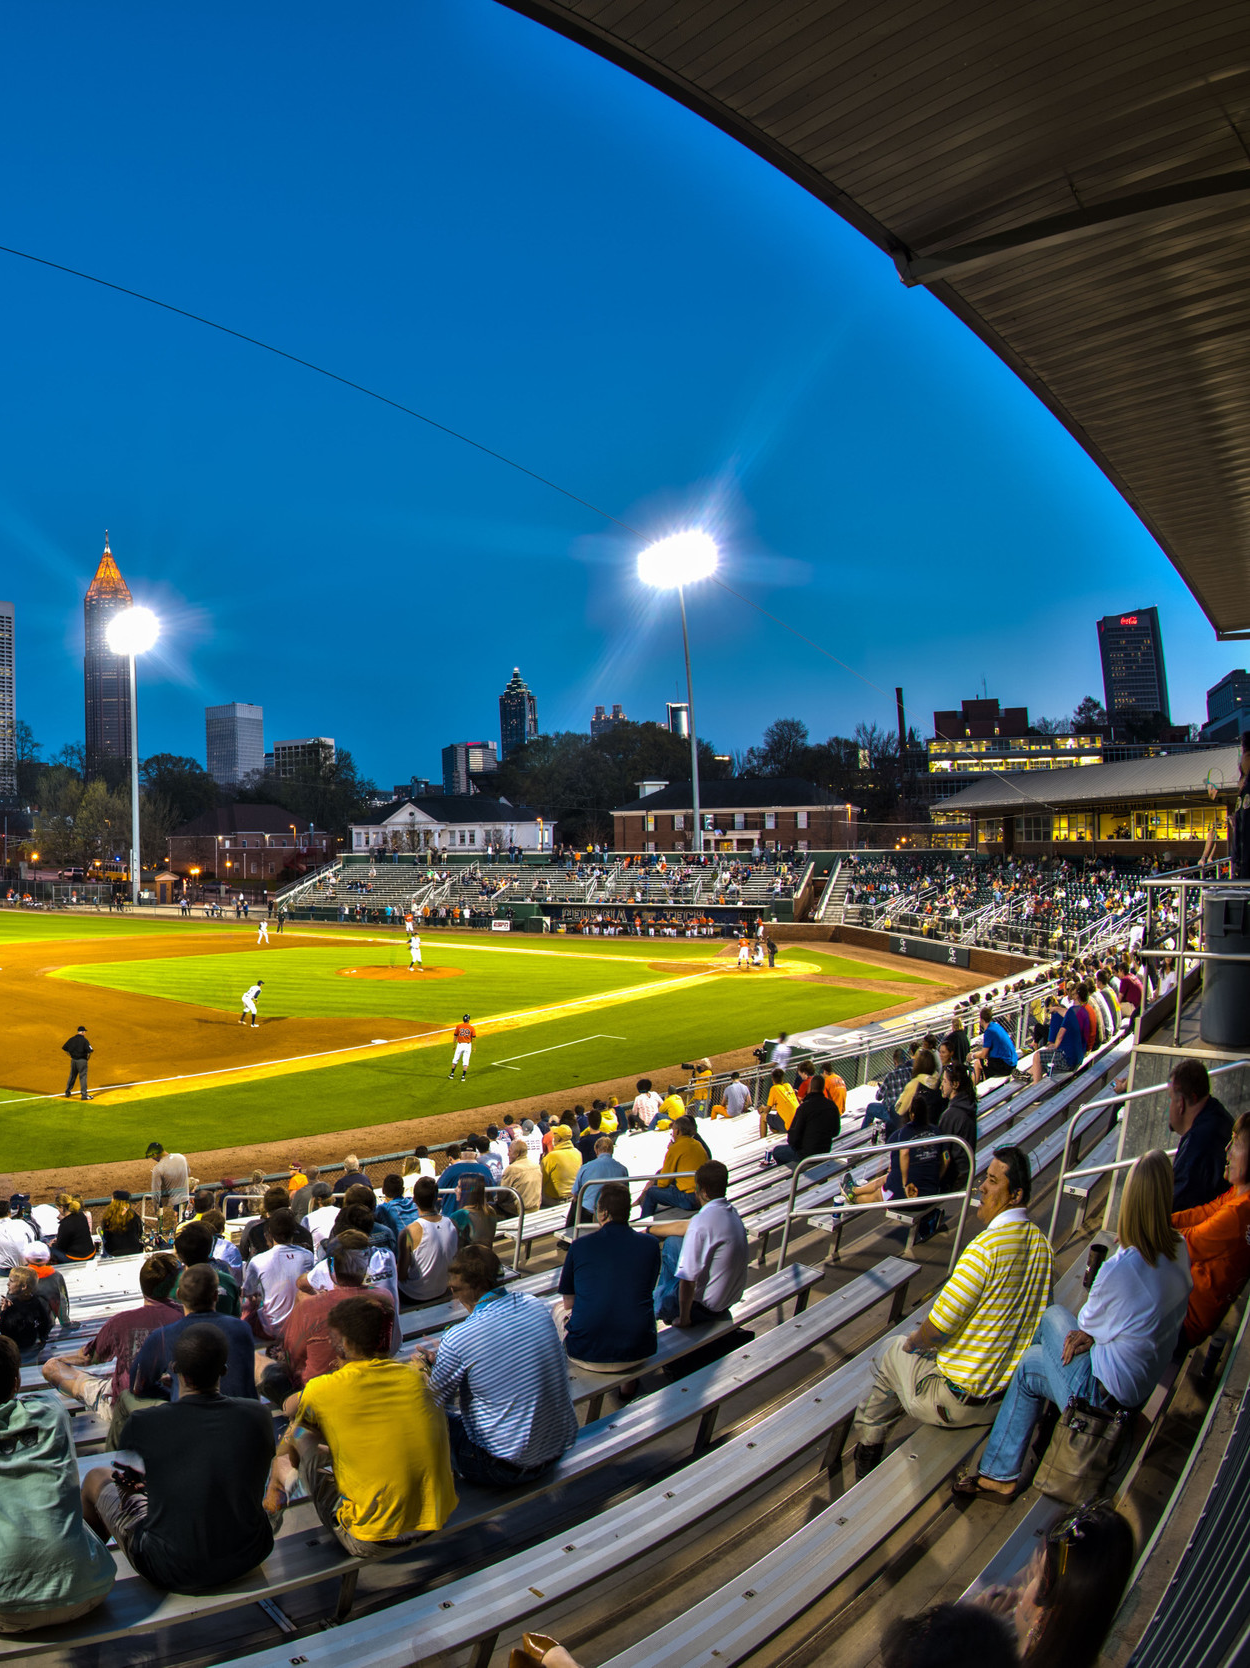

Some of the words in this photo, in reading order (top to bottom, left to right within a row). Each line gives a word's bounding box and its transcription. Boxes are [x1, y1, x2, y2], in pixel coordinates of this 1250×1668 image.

[561, 906, 628, 922] GEORGIA
[663, 908, 705, 924] TECH
[459, 1028, 471, 1037] 29
